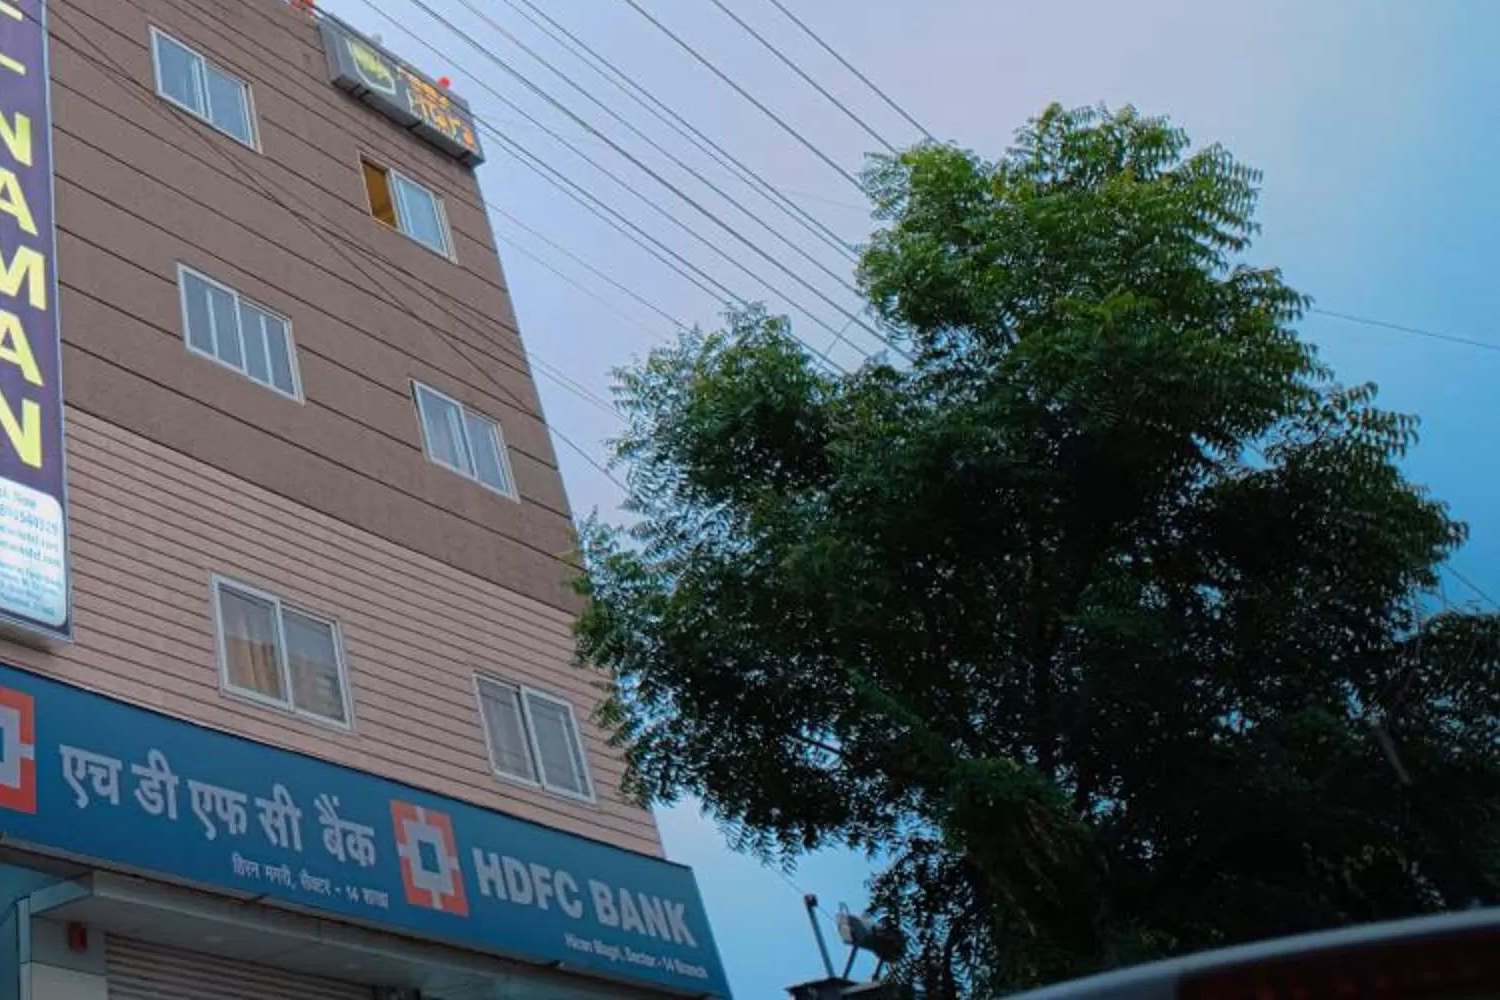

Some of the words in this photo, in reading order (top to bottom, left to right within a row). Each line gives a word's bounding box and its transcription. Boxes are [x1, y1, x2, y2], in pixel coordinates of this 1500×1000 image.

[59, 744, 123, 809] एच
[131, 748, 179, 821] डी
[187, 778, 248, 840] एफ
[255, 783, 302, 851] सी
[314, 793, 377, 867] बैंक
[471, 847, 583, 919] HDFC
[588, 879, 698, 948] BANK
